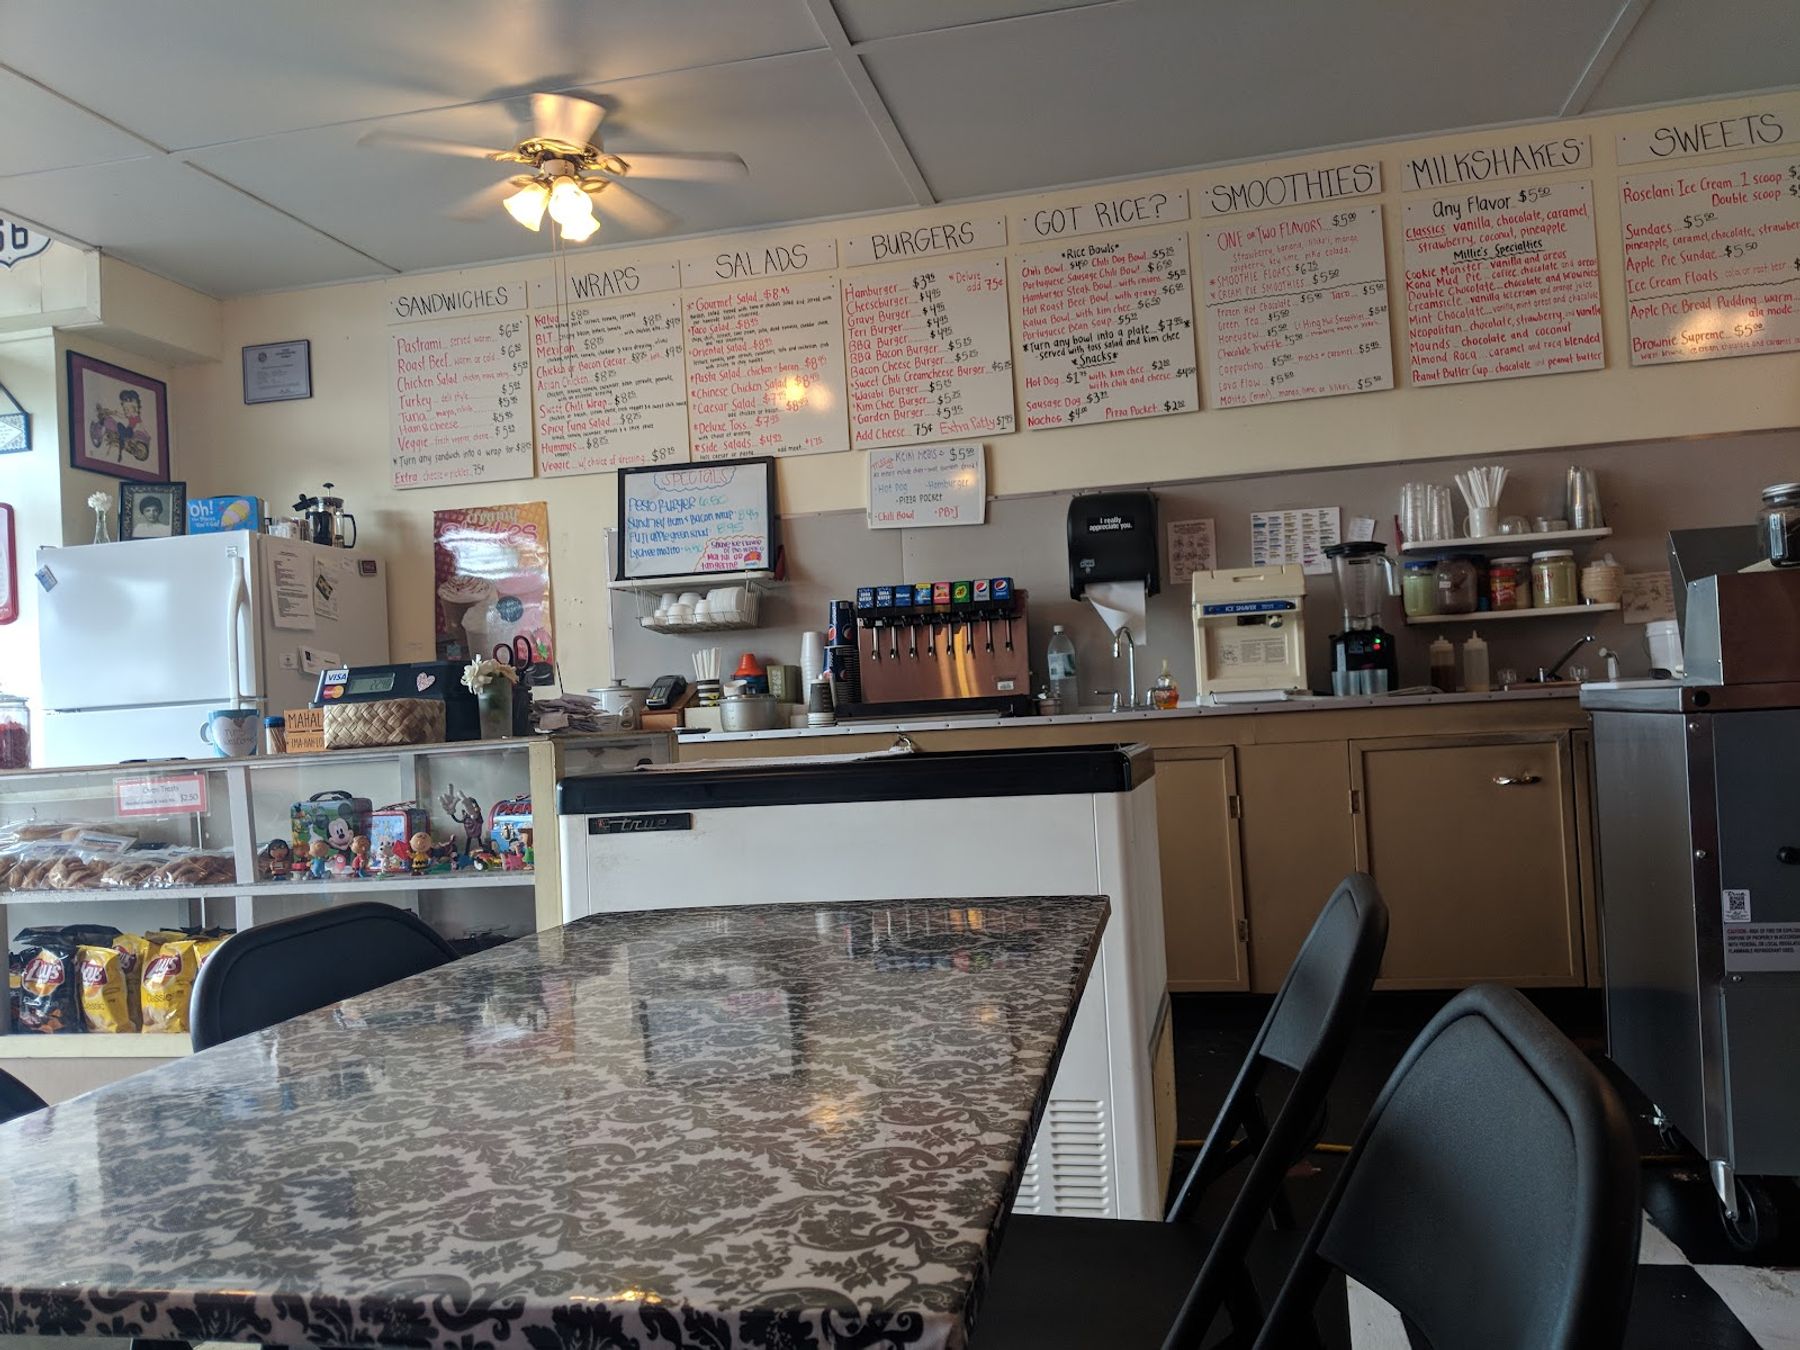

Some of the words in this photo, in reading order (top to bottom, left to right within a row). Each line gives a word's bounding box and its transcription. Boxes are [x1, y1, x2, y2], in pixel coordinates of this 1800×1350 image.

[1649, 113, 1783, 157] SWEETS
[1412, 138, 1580, 189] MILKSHAKES
[1211, 164, 1373, 212] SMOOTHIES
[1623, 187, 1674, 204] Roselani
[1678, 179, 1697, 196] Ice
[1700, 177, 1732, 191] Cream
[1753, 173, 1782, 186] scoop
[1433, 201, 1461, 220] Any
[1468, 195, 1511, 211] Flavor
[1712, 193, 1747, 207] Double
[1752, 189, 1781, 202] scoop
[1034, 206, 1082, 236] GOT
[1094, 193, 1167, 228] RICE?
[871, 222, 975, 260] BURGERS
[1217, 231, 1243, 251] ONE
[1280, 218, 1322, 236] FLAVORS
[1406, 224, 1445, 239] Classics
[1626, 223, 1672, 240] Sundaes
[1066, 248, 1086, 259] Rice
[1088, 245, 1115, 256] Bowls
[1453, 247, 1488, 261] Millie's
[1495, 239, 1543, 254] Specialties
[715, 244, 808, 278] SALADS
[1044, 264, 1064, 274] Bowl
[1128, 251, 1147, 263] Bowl
[1406, 269, 1436, 280] Cookie
[1440, 262, 1482, 278] Monster
[1490, 257, 1521, 269] vanilla
[1524, 254, 1540, 265] and
[571, 266, 640, 298] WRAPS
[1066, 286, 1091, 297] Steak
[1406, 280, 1431, 290] Kona
[1436, 276, 1458, 286] Mud
[1408, 290, 1444, 301] Double
[1448, 281, 1495, 296] Chocolate
[1504, 276, 1541, 289] chocolate
[1627, 278, 1647, 294] Ice
[1650, 275, 1681, 289] Cream
[1685, 270, 1719, 285] Floats
[396, 286, 508, 317] SANDWICHES
[696, 295, 732, 311] Gourmet
[737, 290, 758, 303] Salad
[845, 285, 897, 301] Hamburger
[1470, 292, 1500, 304] vanilla
[846, 297, 909, 315] Cheeseburger
[1022, 304, 1037, 316] Hot
[1041, 299, 1064, 311] Roast
[1090, 290, 1109, 303] Bowl
[1114, 291, 1132, 301] with
[1630, 305, 1658, 320] Apple
[1681, 299, 1711, 312] Bread
[1717, 295, 1757, 312] Pudding
[1764, 293, 1793, 304] warm
[848, 314, 875, 328] Gravy
[879, 309, 912, 323] Burger
[1022, 317, 1046, 329] Kalua
[1050, 313, 1070, 324] Bowl
[1075, 310, 1094, 320] with
[1409, 313, 1431, 325] Mint
[1437, 307, 1484, 322] Chocolate
[536, 333, 553, 345] BLT
[849, 327, 868, 339] Teri
[871, 323, 903, 337] Burger
[1054, 339, 1070, 350] any
[1073, 333, 1093, 346] bowl
[1097, 331, 1114, 342] into
[1118, 331, 1124, 340] a
[1128, 325, 1150, 338] plate
[1410, 340, 1450, 353] Mounds
[1461, 332, 1506, 347] chocolate
[1511, 328, 1529, 339] and
[1535, 322, 1571, 336] coconut
[397, 336, 442, 356] Pastrami
[692, 344, 725, 357] Oriental
[726, 341, 747, 353] Salad
[849, 340, 871, 353] BBQ
[877, 335, 908, 350] Burger
[1039, 348, 1066, 361] served
[1068, 345, 1084, 355] with
[1087, 341, 1102, 351] toss
[1104, 339, 1123, 348] salad
[1126, 337, 1141, 346] and
[1144, 335, 1159, 344] kim
[1411, 353, 1447, 366] Almond
[1489, 343, 1525, 358] caramel
[1564, 332, 1600, 347] blended
[1632, 335, 1679, 353] Brownie
[1681, 329, 1724, 347] Supreme
[398, 357, 425, 373] Roast
[429, 352, 449, 370] Beef
[850, 352, 871, 364] BBQ
[876, 349, 904, 361] Bacon
[907, 345, 940, 357] Burger
[1079, 351, 1112, 366] Snacks
[851, 366, 880, 378] Bacon
[882, 361, 911, 373] Cheese
[914, 357, 945, 370] Burger
[958, 365, 985, 376] Burger
[1412, 368, 1441, 383] Peanut
[1443, 367, 1469, 380] Butter
[1472, 365, 1488, 378] Cup
[1495, 359, 1531, 373] chocolate
[398, 377, 433, 393] Chicken
[437, 372, 457, 387] Salad
[1025, 376, 1041, 388] Hot
[1044, 376, 1059, 386] Dog
[1089, 372, 1107, 381] with
[697, 387, 728, 400] Chinese
[731, 383, 762, 394] Chicken
[889, 385, 919, 397] Burger
[400, 394, 432, 412] Turkey
[731, 399, 756, 412] Salad
[898, 396, 928, 408] Burger
[1026, 398, 1062, 411] Sausage
[1064, 396, 1081, 407] Dog
[699, 422, 727, 434] Deluxe
[730, 418, 747, 430] Toss
[857, 413, 890, 425] Garden
[894, 409, 924, 421] Burger
[398, 436, 429, 454] Veggie
[856, 430, 873, 442] Add
[701, 443, 718, 453] Side
[723, 439, 752, 449] Salads
[1089, 523, 1119, 531] appreciate
